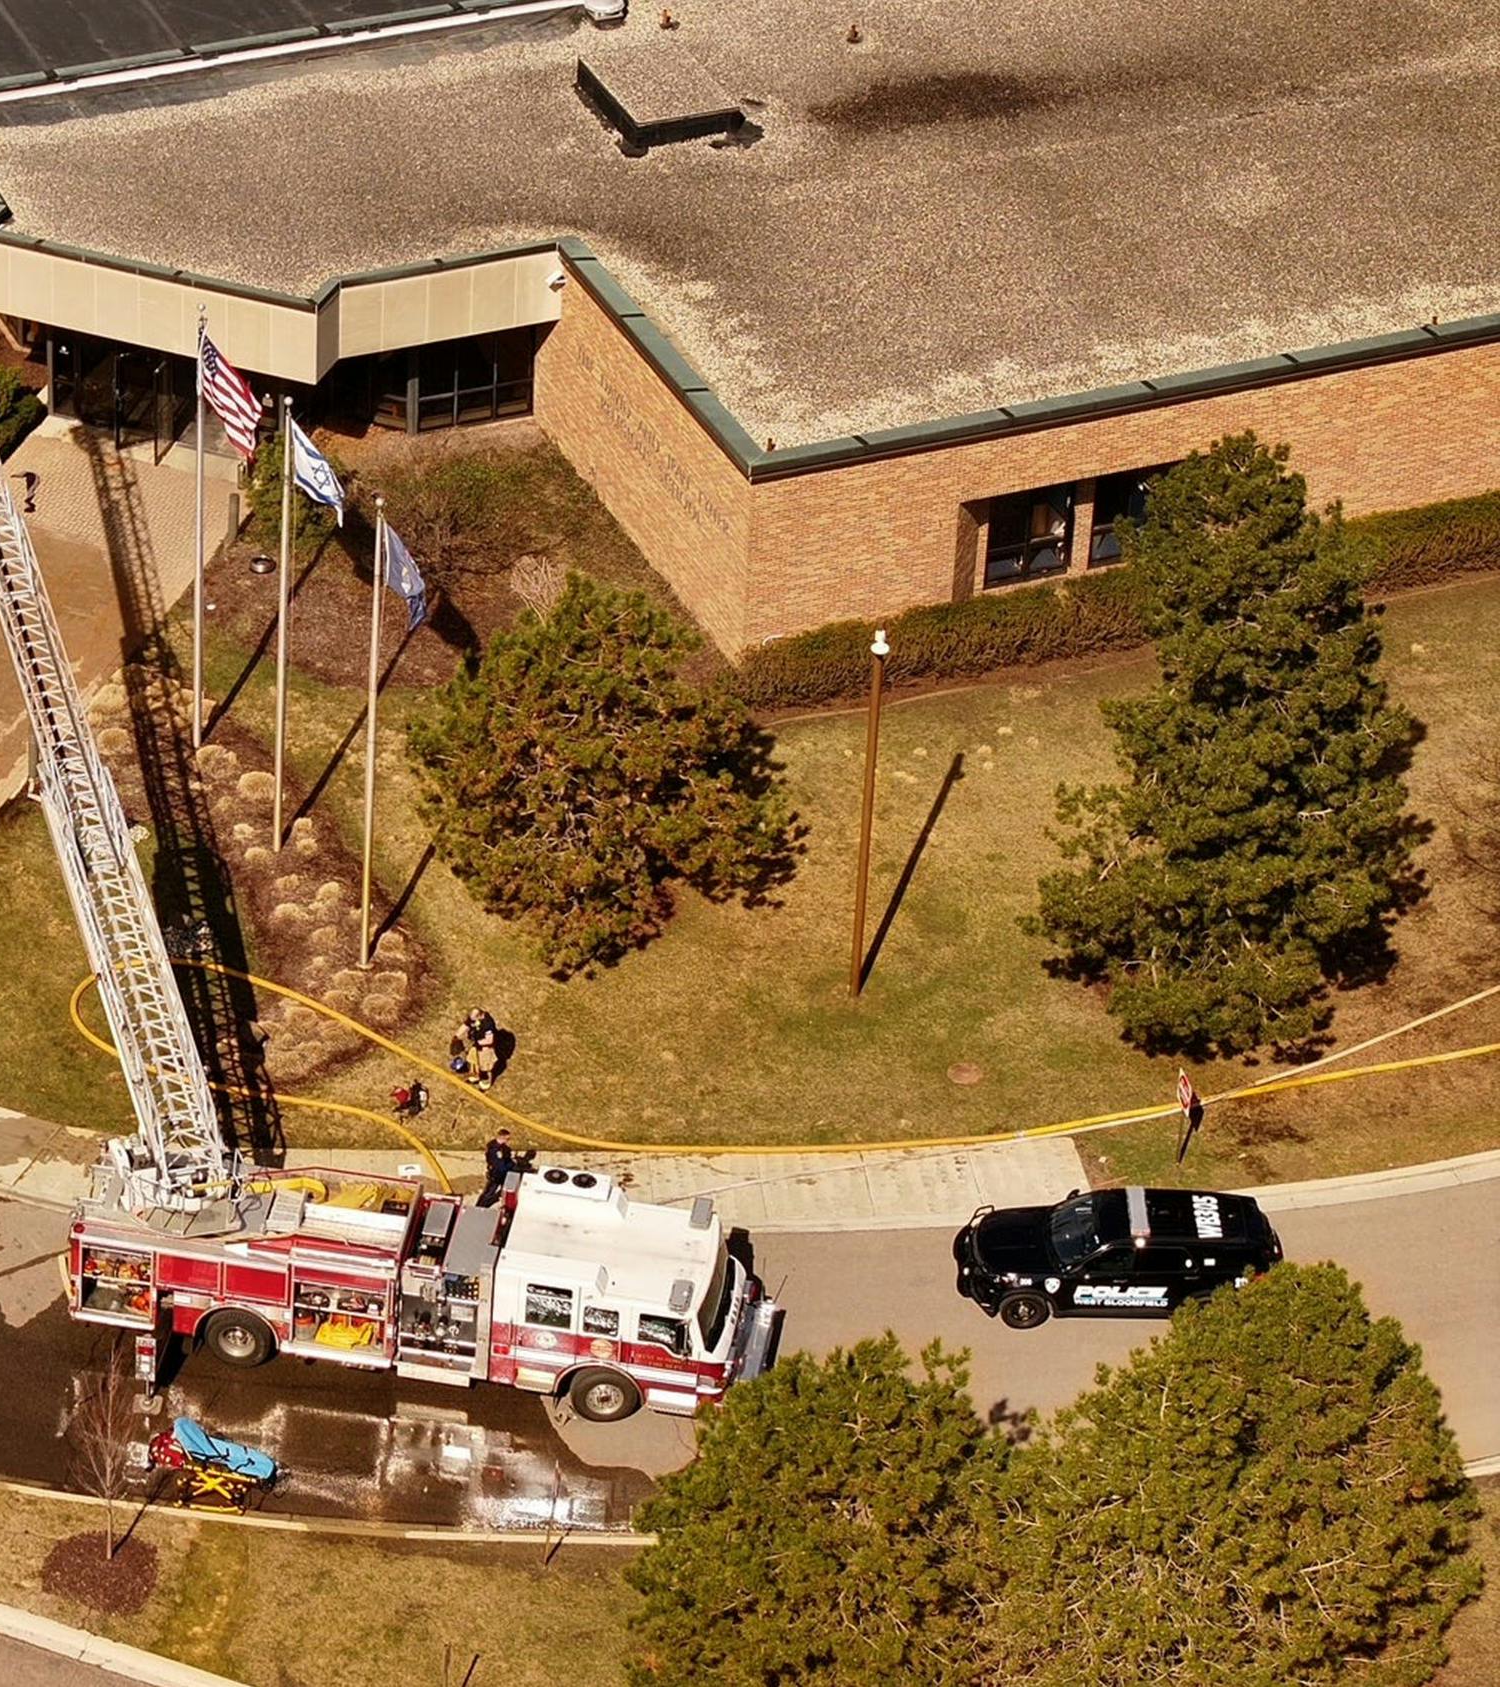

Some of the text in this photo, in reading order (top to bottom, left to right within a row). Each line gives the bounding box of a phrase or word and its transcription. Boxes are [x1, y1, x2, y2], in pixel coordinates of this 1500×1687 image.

[1192, 1194, 1223, 1238] WB305
[1074, 1285, 1168, 1300] POLICE
[1104, 1298, 1168, 1307] BLOOMFIELD
